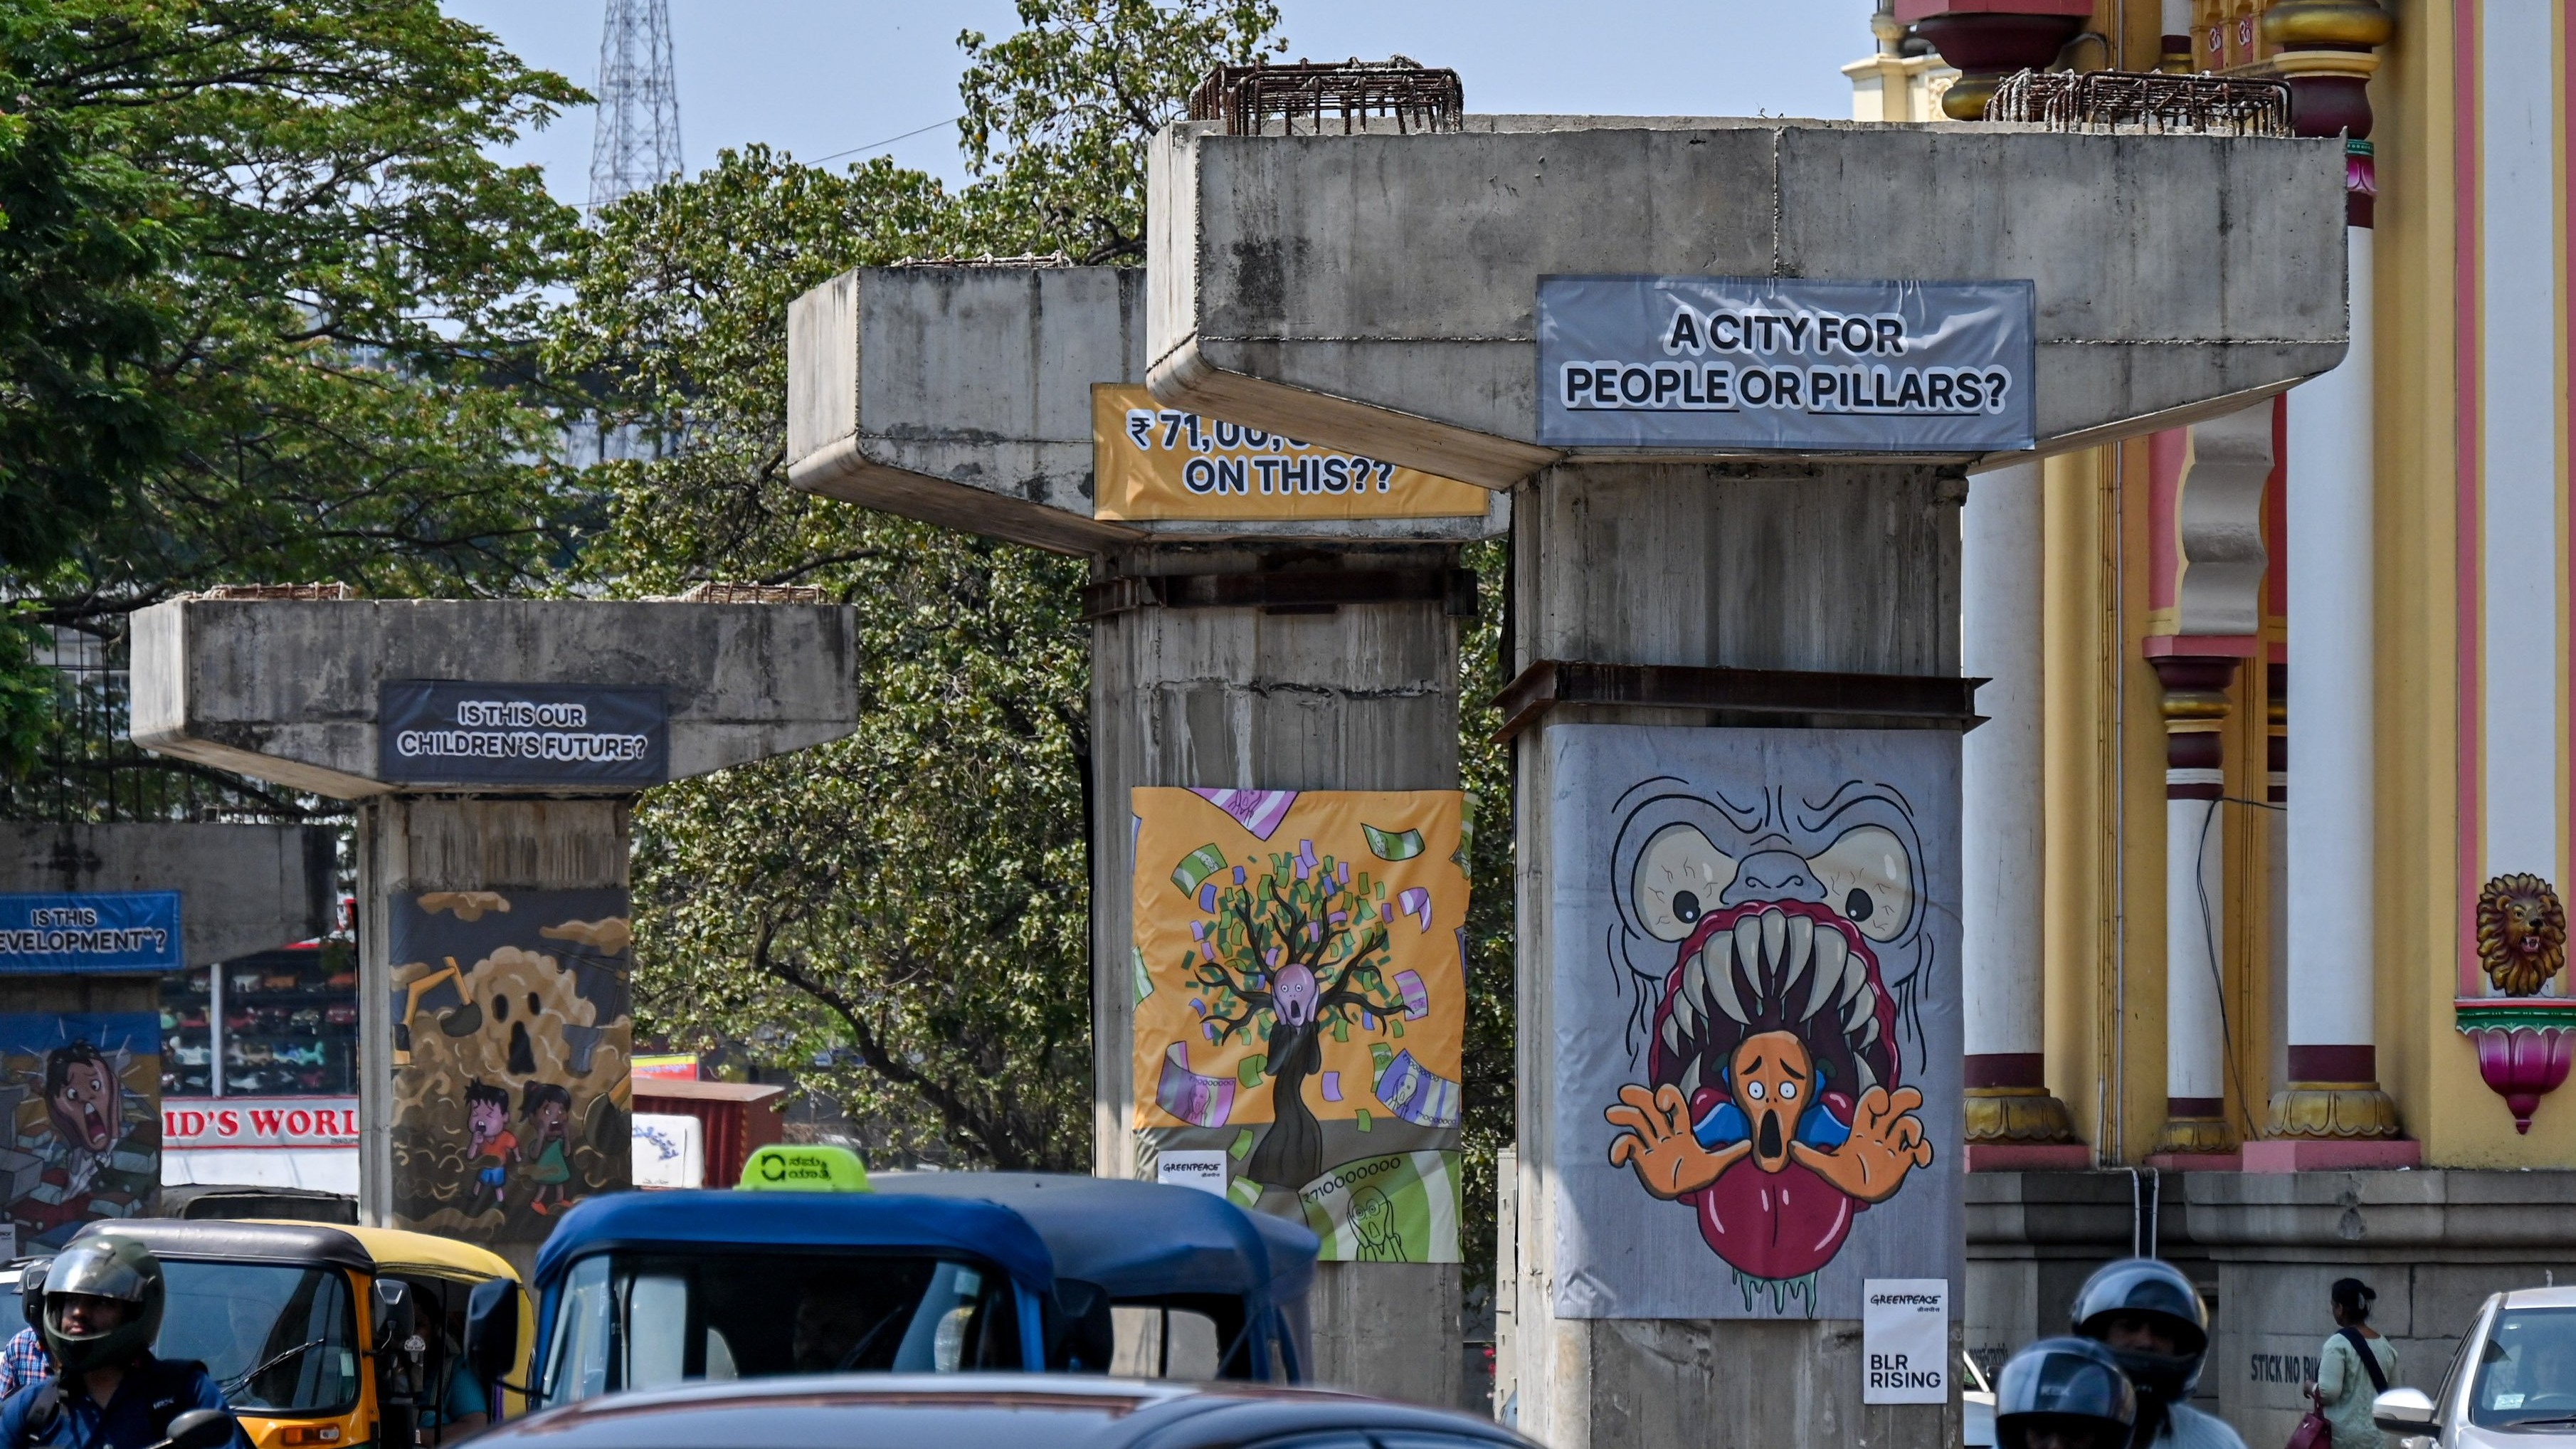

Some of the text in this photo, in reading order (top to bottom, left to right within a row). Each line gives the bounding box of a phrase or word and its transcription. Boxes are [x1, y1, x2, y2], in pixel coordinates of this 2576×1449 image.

[1670, 313, 1904, 354] A CITY FOR
[1566, 368, 2007, 409] PEOPLE OR PILLARS?
[1187, 459, 1395, 493] ON THIS??
[460, 705, 584, 726] IS THIS OUR
[401, 733, 647, 757] CHILDREN’S FUTURE?
[33, 910, 96, 926] IS THIS
[163, 1110, 239, 1137] ID'S
[1163, 1163, 1221, 1173] GREENPEACE
[1870, 1295, 1942, 1306] GREENPEACE
[1870, 1354, 1909, 1371] BLR
[2250, 1354, 2283, 1383] STICK
[2285, 1355, 2301, 1384] NO
[1870, 1371, 1941, 1389] RISING
